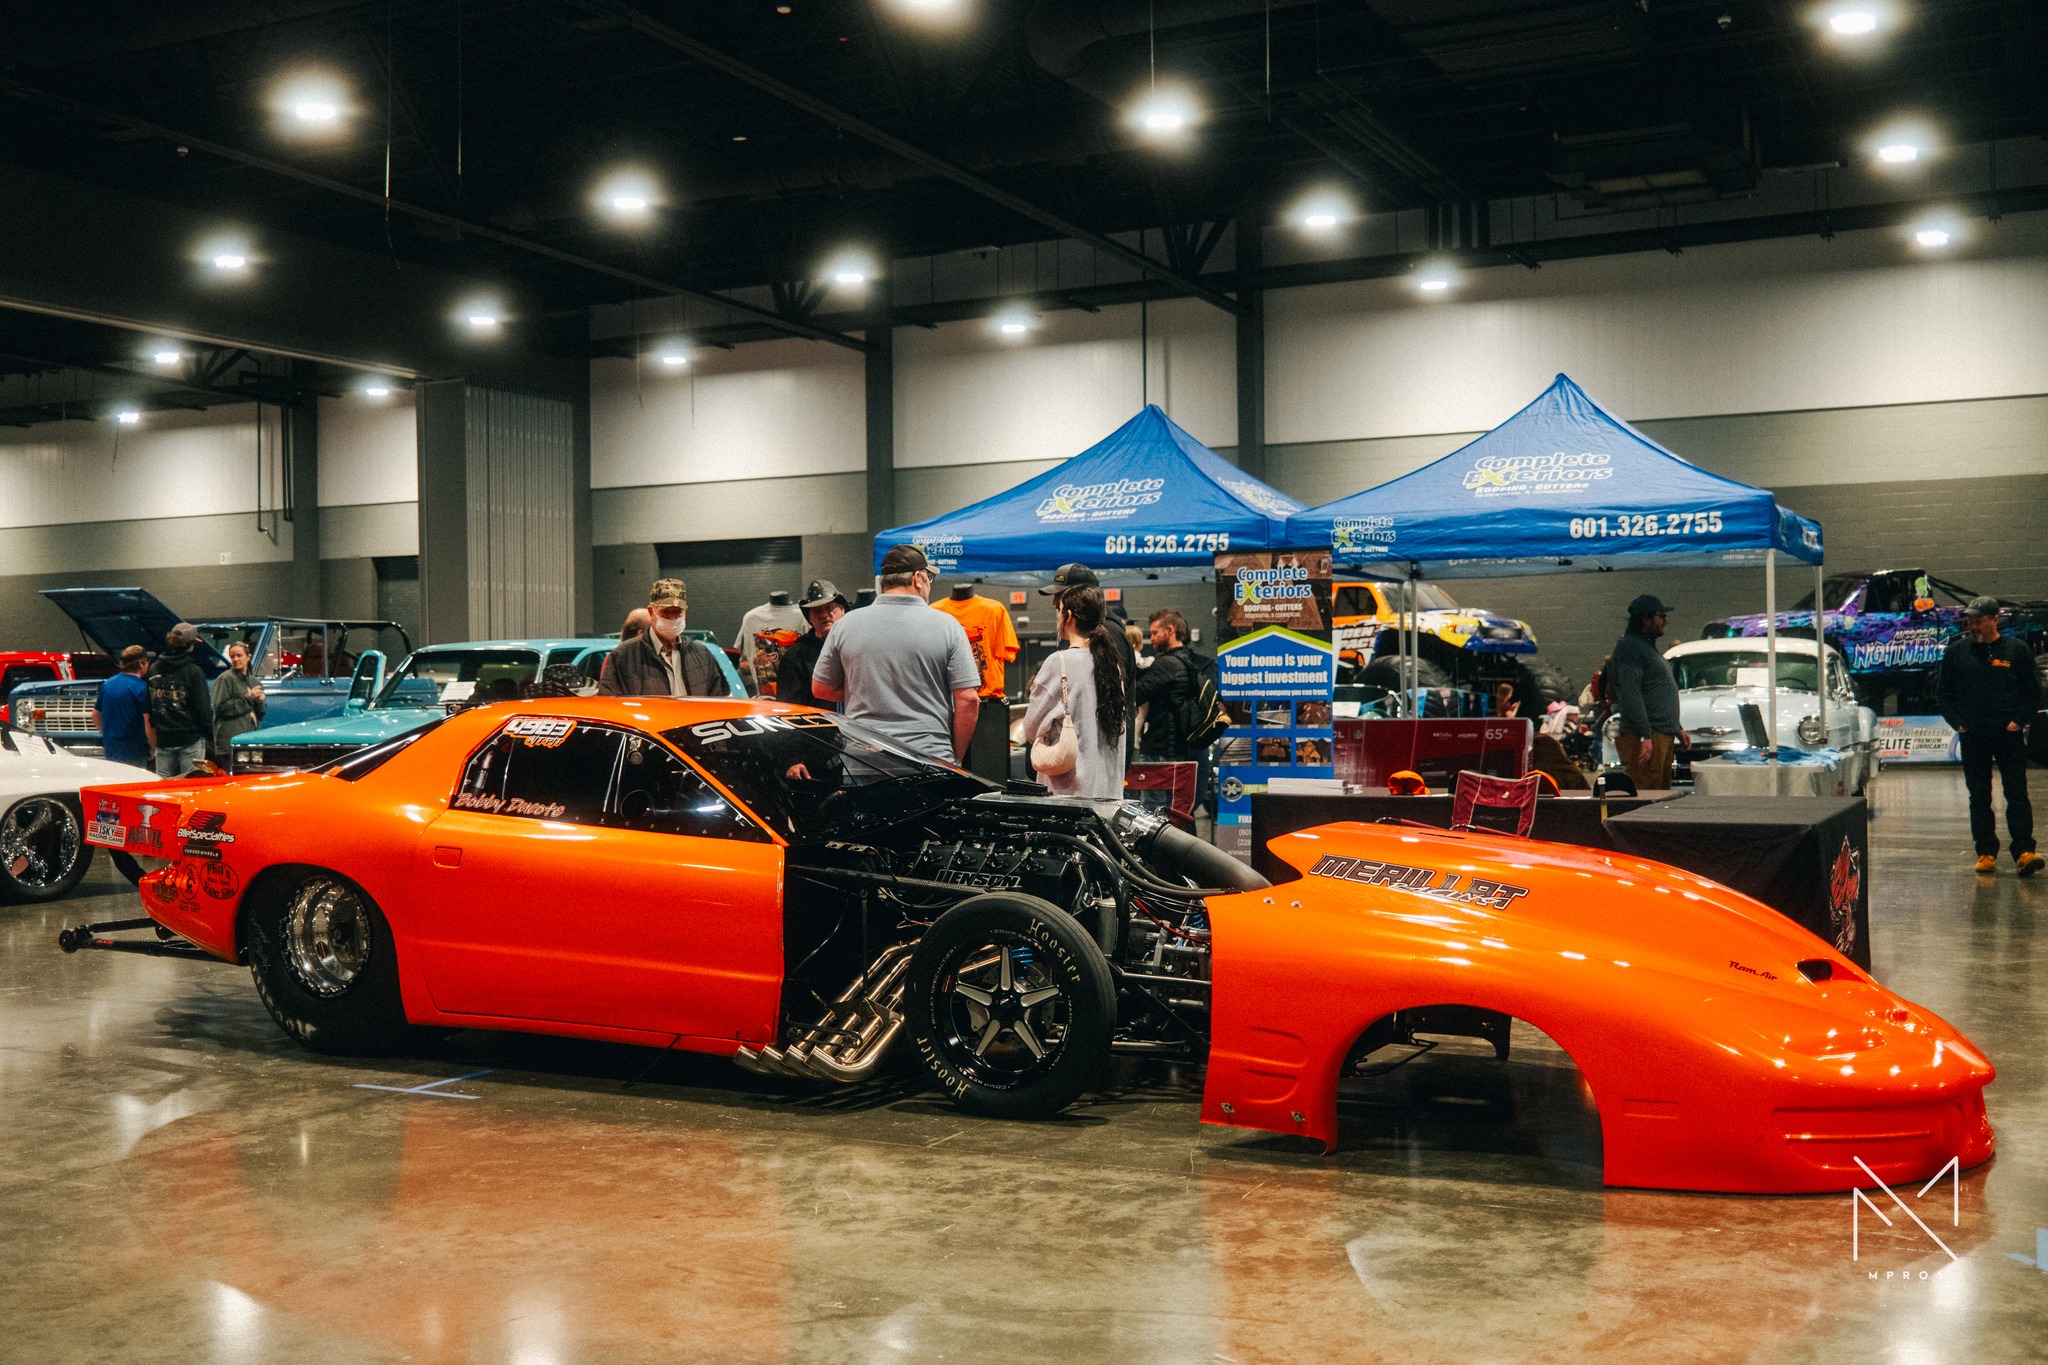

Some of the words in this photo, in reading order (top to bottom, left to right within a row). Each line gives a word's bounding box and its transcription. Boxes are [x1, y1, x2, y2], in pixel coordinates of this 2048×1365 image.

[1475, 452, 1610, 471] Complete
[1053, 478, 1164, 498] Complete
[1476, 484, 1527, 493] ROOFING
[1091, 508, 1137, 517] GUTTERS
[1334, 516, 1394, 532] Complete
[1570, 511, 1723, 538] 601.326.2755
[912, 534, 963, 546] Complete
[1105, 533, 1230, 554] 601.326.2755
[1238, 566, 1308, 584] Complete
[1275, 604, 1302, 612] GUTTERS
[1225, 654, 1250, 667] Your
[1251, 654, 1283, 667] home
[1285, 654, 1295, 666] is
[1297, 655, 1323, 667] your
[1222, 672, 1262, 685] biggest
[1264, 671, 1328, 684] investment
[506, 720, 573, 736] 4983
[1880, 738, 1911, 750] ELITE
[454, 792, 507, 814] Bobby
[99, 825, 116, 836] ISKY
[128, 826, 163, 848] ANVIL
[208, 863, 231, 879] Phil's
[1309, 853, 1529, 910] MERILLAT
[1026, 918, 1080, 982] Hoosier
[1730, 961, 1759, 976] Ram
[1760, 972, 1777, 980] Air
[917, 1037, 972, 1099] Hoosier
